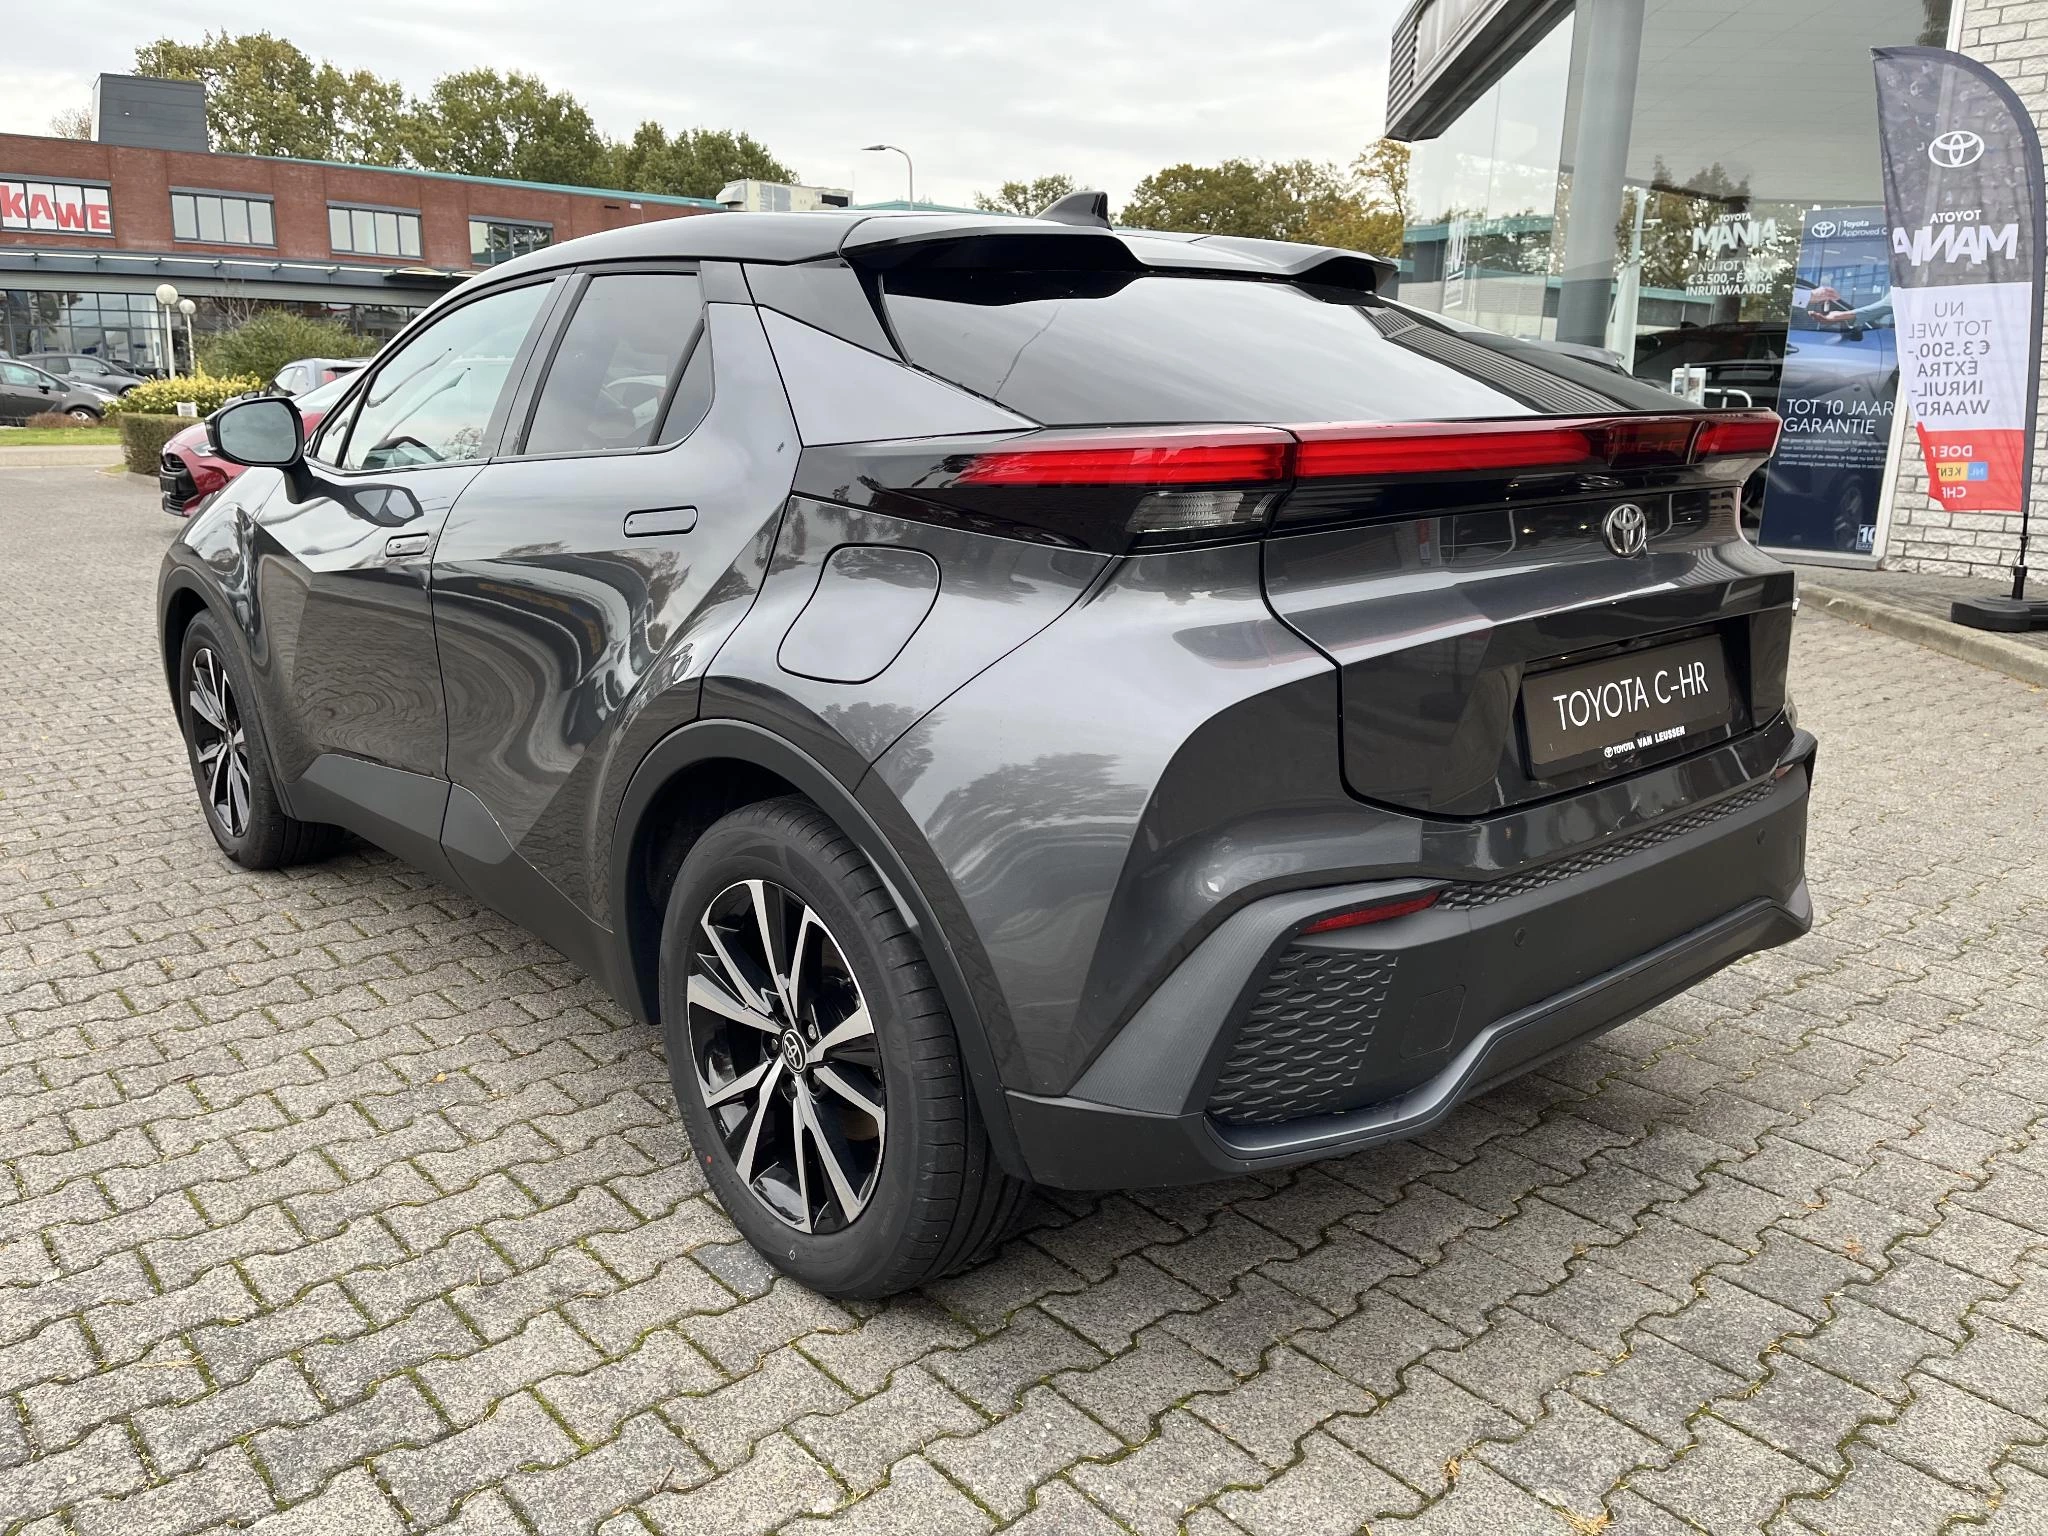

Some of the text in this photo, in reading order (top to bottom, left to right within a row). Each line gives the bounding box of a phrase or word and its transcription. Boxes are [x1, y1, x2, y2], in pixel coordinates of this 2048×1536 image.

[1719, 212, 1751, 223] TOYOTA
[1842, 220, 1870, 229] Toyota
[1692, 217, 1777, 251] MANIA
[1841, 227, 1879, 238] Approved
[1698, 261, 1715, 272] NU
[1719, 260, 1739, 272] TOT
[1685, 283, 1773, 297] INRUILWAARDE
[1786, 399, 1894, 416] TOT 10 JAAR
[1783, 417, 1876, 435] GARANTIE
[1553, 661, 1709, 731] TOYOTA C-HR
[1613, 725, 1686, 755] TOYOTA VAN LEUSSEN
